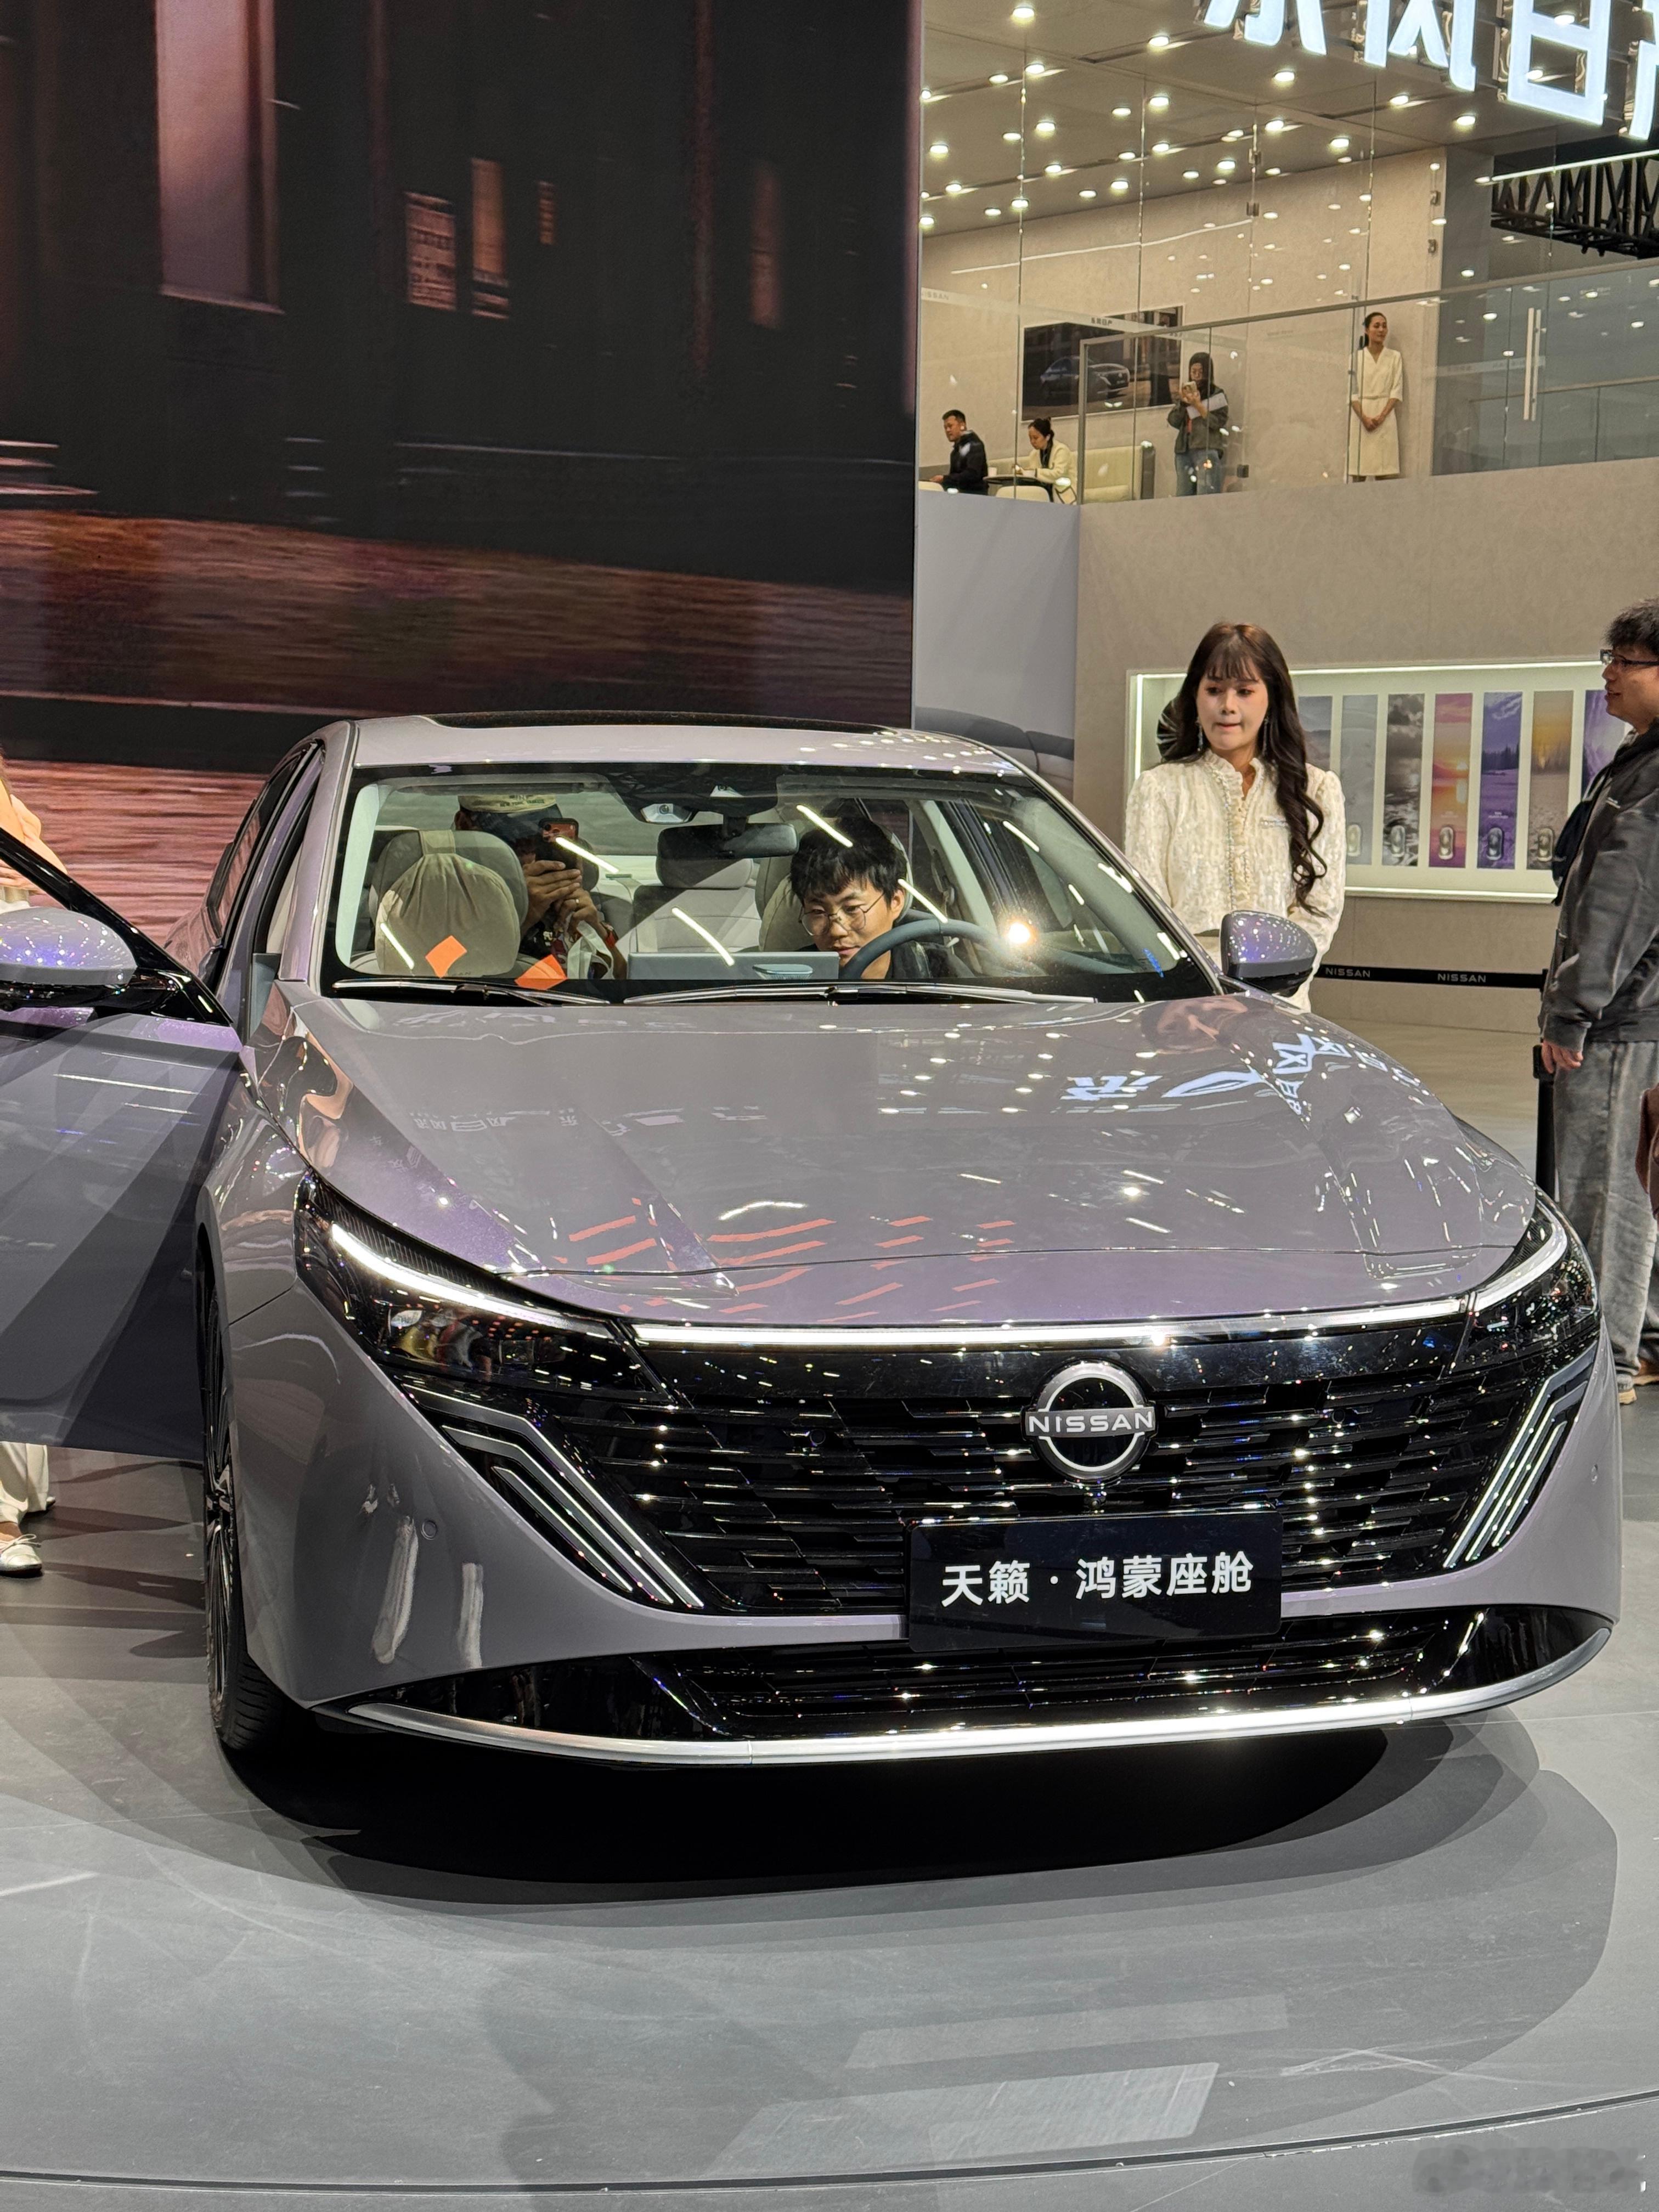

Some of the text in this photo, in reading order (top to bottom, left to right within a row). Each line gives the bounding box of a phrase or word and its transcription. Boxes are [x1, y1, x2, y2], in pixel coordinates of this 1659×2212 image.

[1325, 967, 1370, 978] NISSAN
[1437, 973, 1486, 983] NISSAN
[1029, 1411, 1153, 1432] NISSAN
